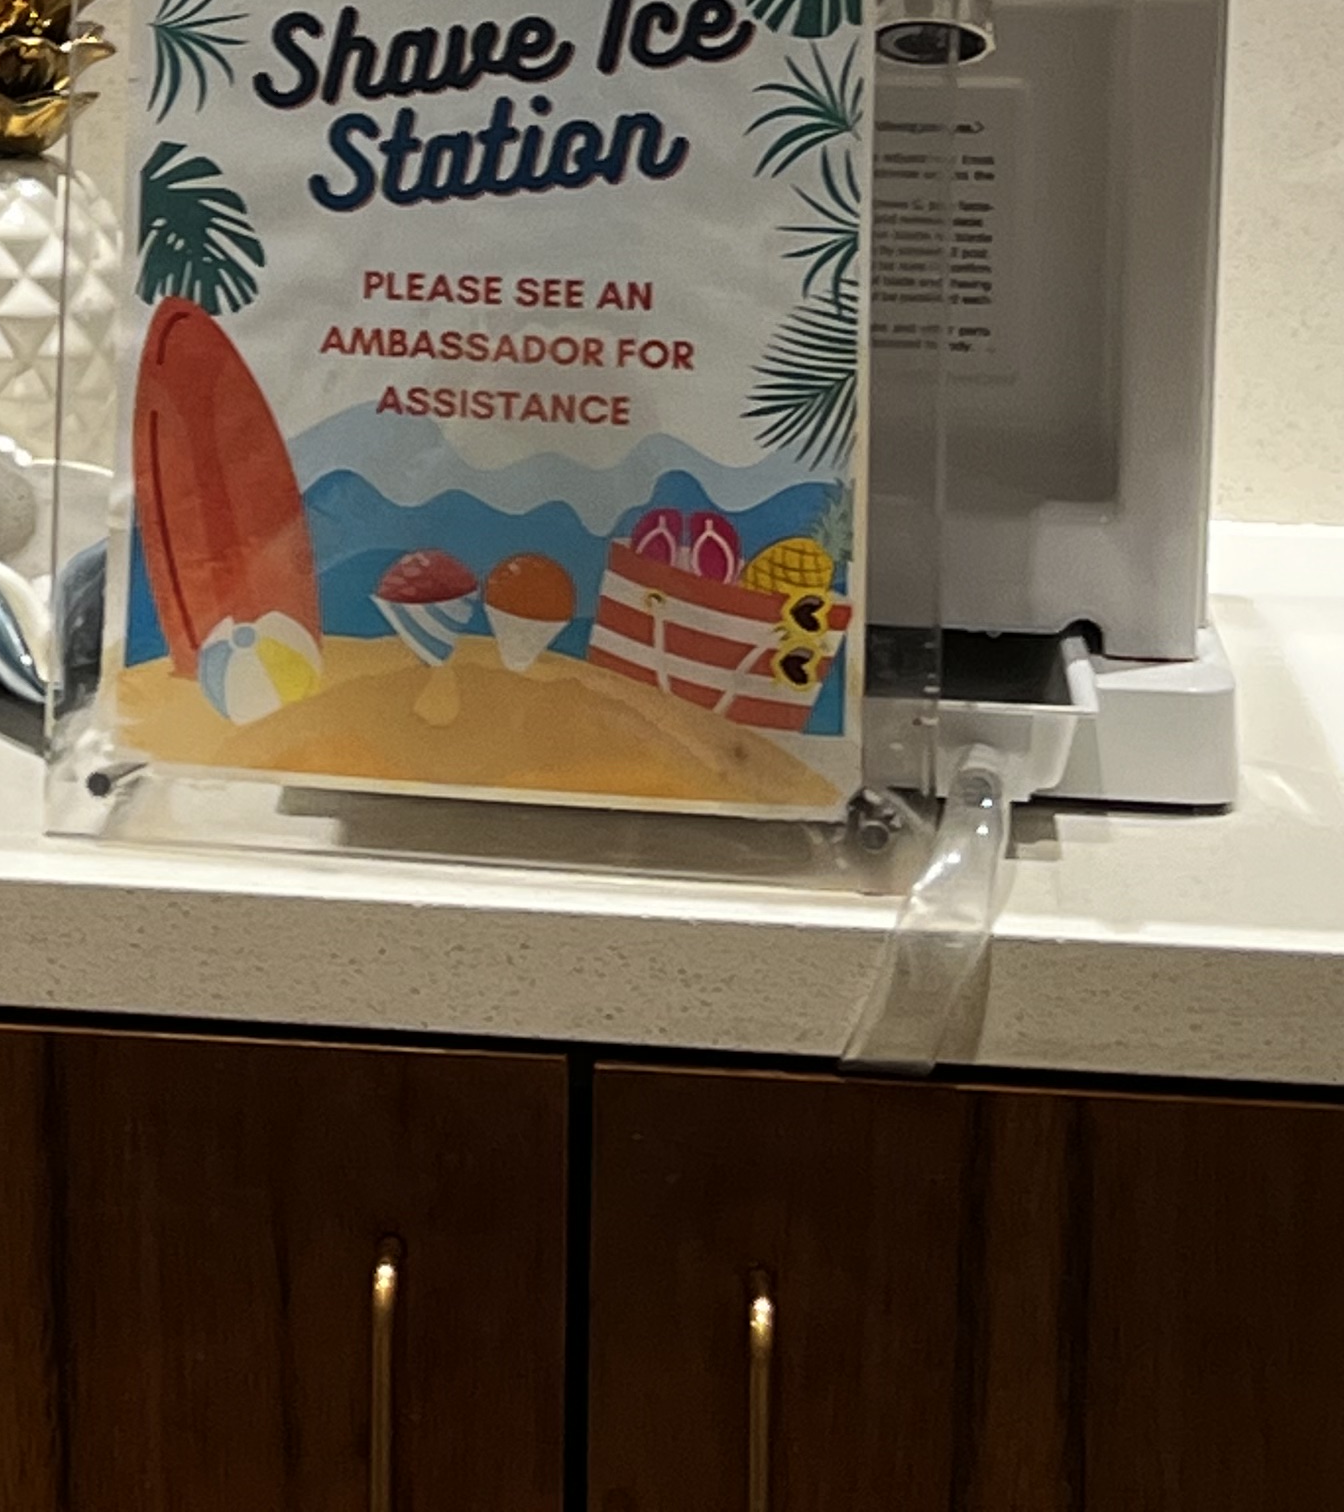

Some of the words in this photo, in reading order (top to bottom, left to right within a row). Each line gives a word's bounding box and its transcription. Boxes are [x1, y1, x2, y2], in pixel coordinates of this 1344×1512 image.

[253, 6, 575, 109] Shave
[308, 95, 690, 212] Station
[363, 270, 502, 305] PLEASE
[515, 279, 585, 309] SEE
[596, 281, 654, 312] AN
[320, 326, 604, 367] AMBASSADOR
[617, 340, 695, 370] FOR
[375, 386, 631, 426] ASSISTANCE
